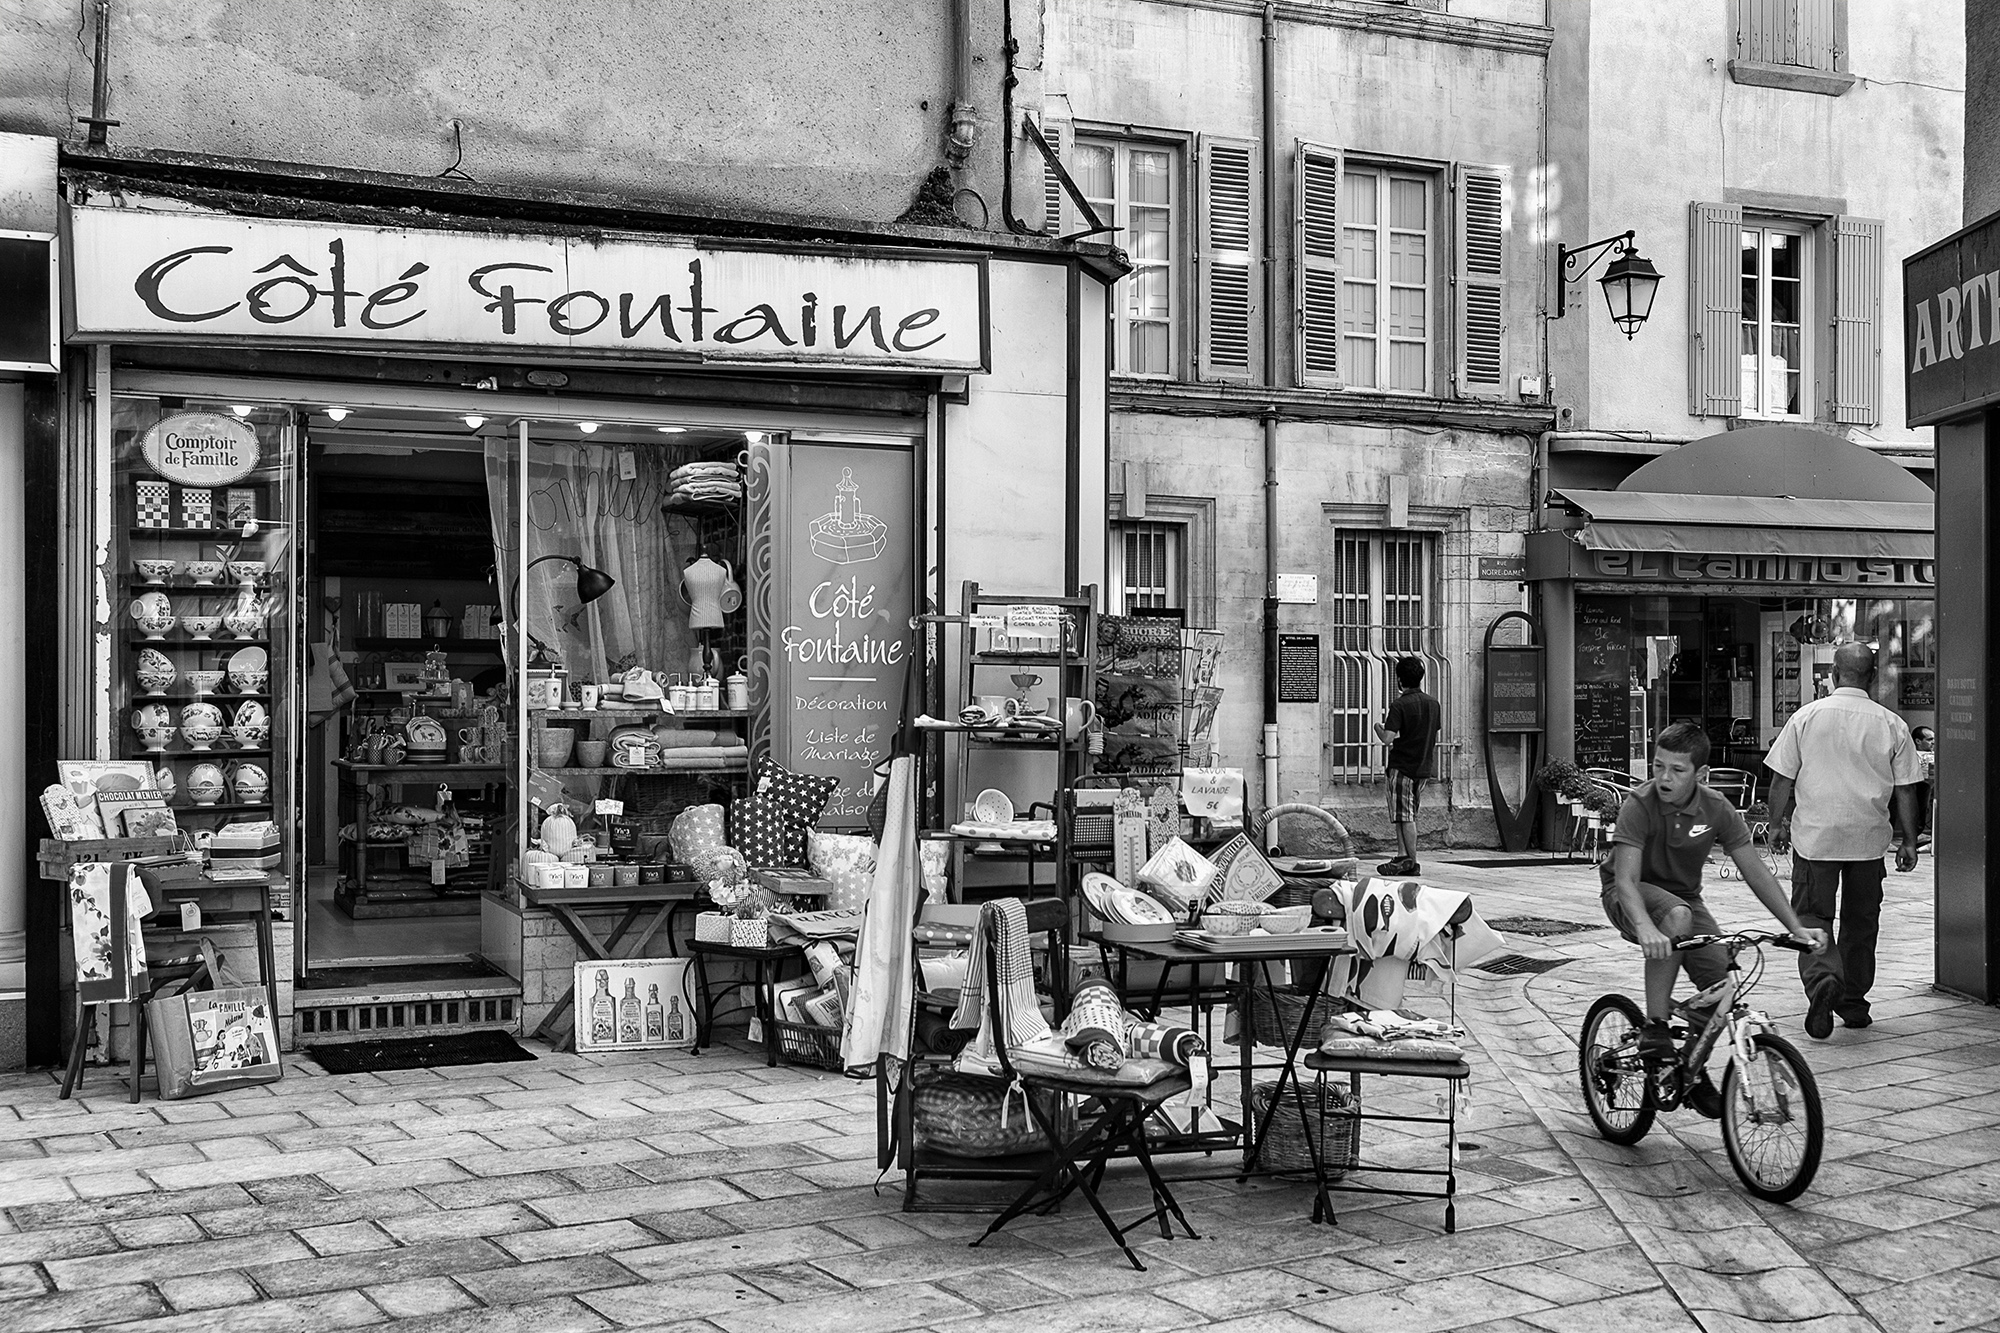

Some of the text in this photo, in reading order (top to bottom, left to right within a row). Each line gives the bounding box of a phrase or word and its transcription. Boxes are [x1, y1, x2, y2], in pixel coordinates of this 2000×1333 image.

[135, 238, 946, 353] Côté Fontaine
[165, 432, 237, 453] Comptoir
[165, 450, 239, 468] de Famille
[1481, 569, 1522, 577] NOTRE-DAME
[808, 575, 876, 619] Côté
[781, 620, 904, 665] Fontaine
[1124, 635, 1168, 643] STORY
[795, 693, 888, 711] Décoration
[1136, 712, 1178, 721] ADDICT
[805, 727, 876, 744] Liste de
[800, 746, 880, 768] Mariage
[1209, 775, 1217, 785] &
[98, 790, 163, 802] CHOCOLAT MENIER
[1191, 786, 1231, 794] LAVANDE
